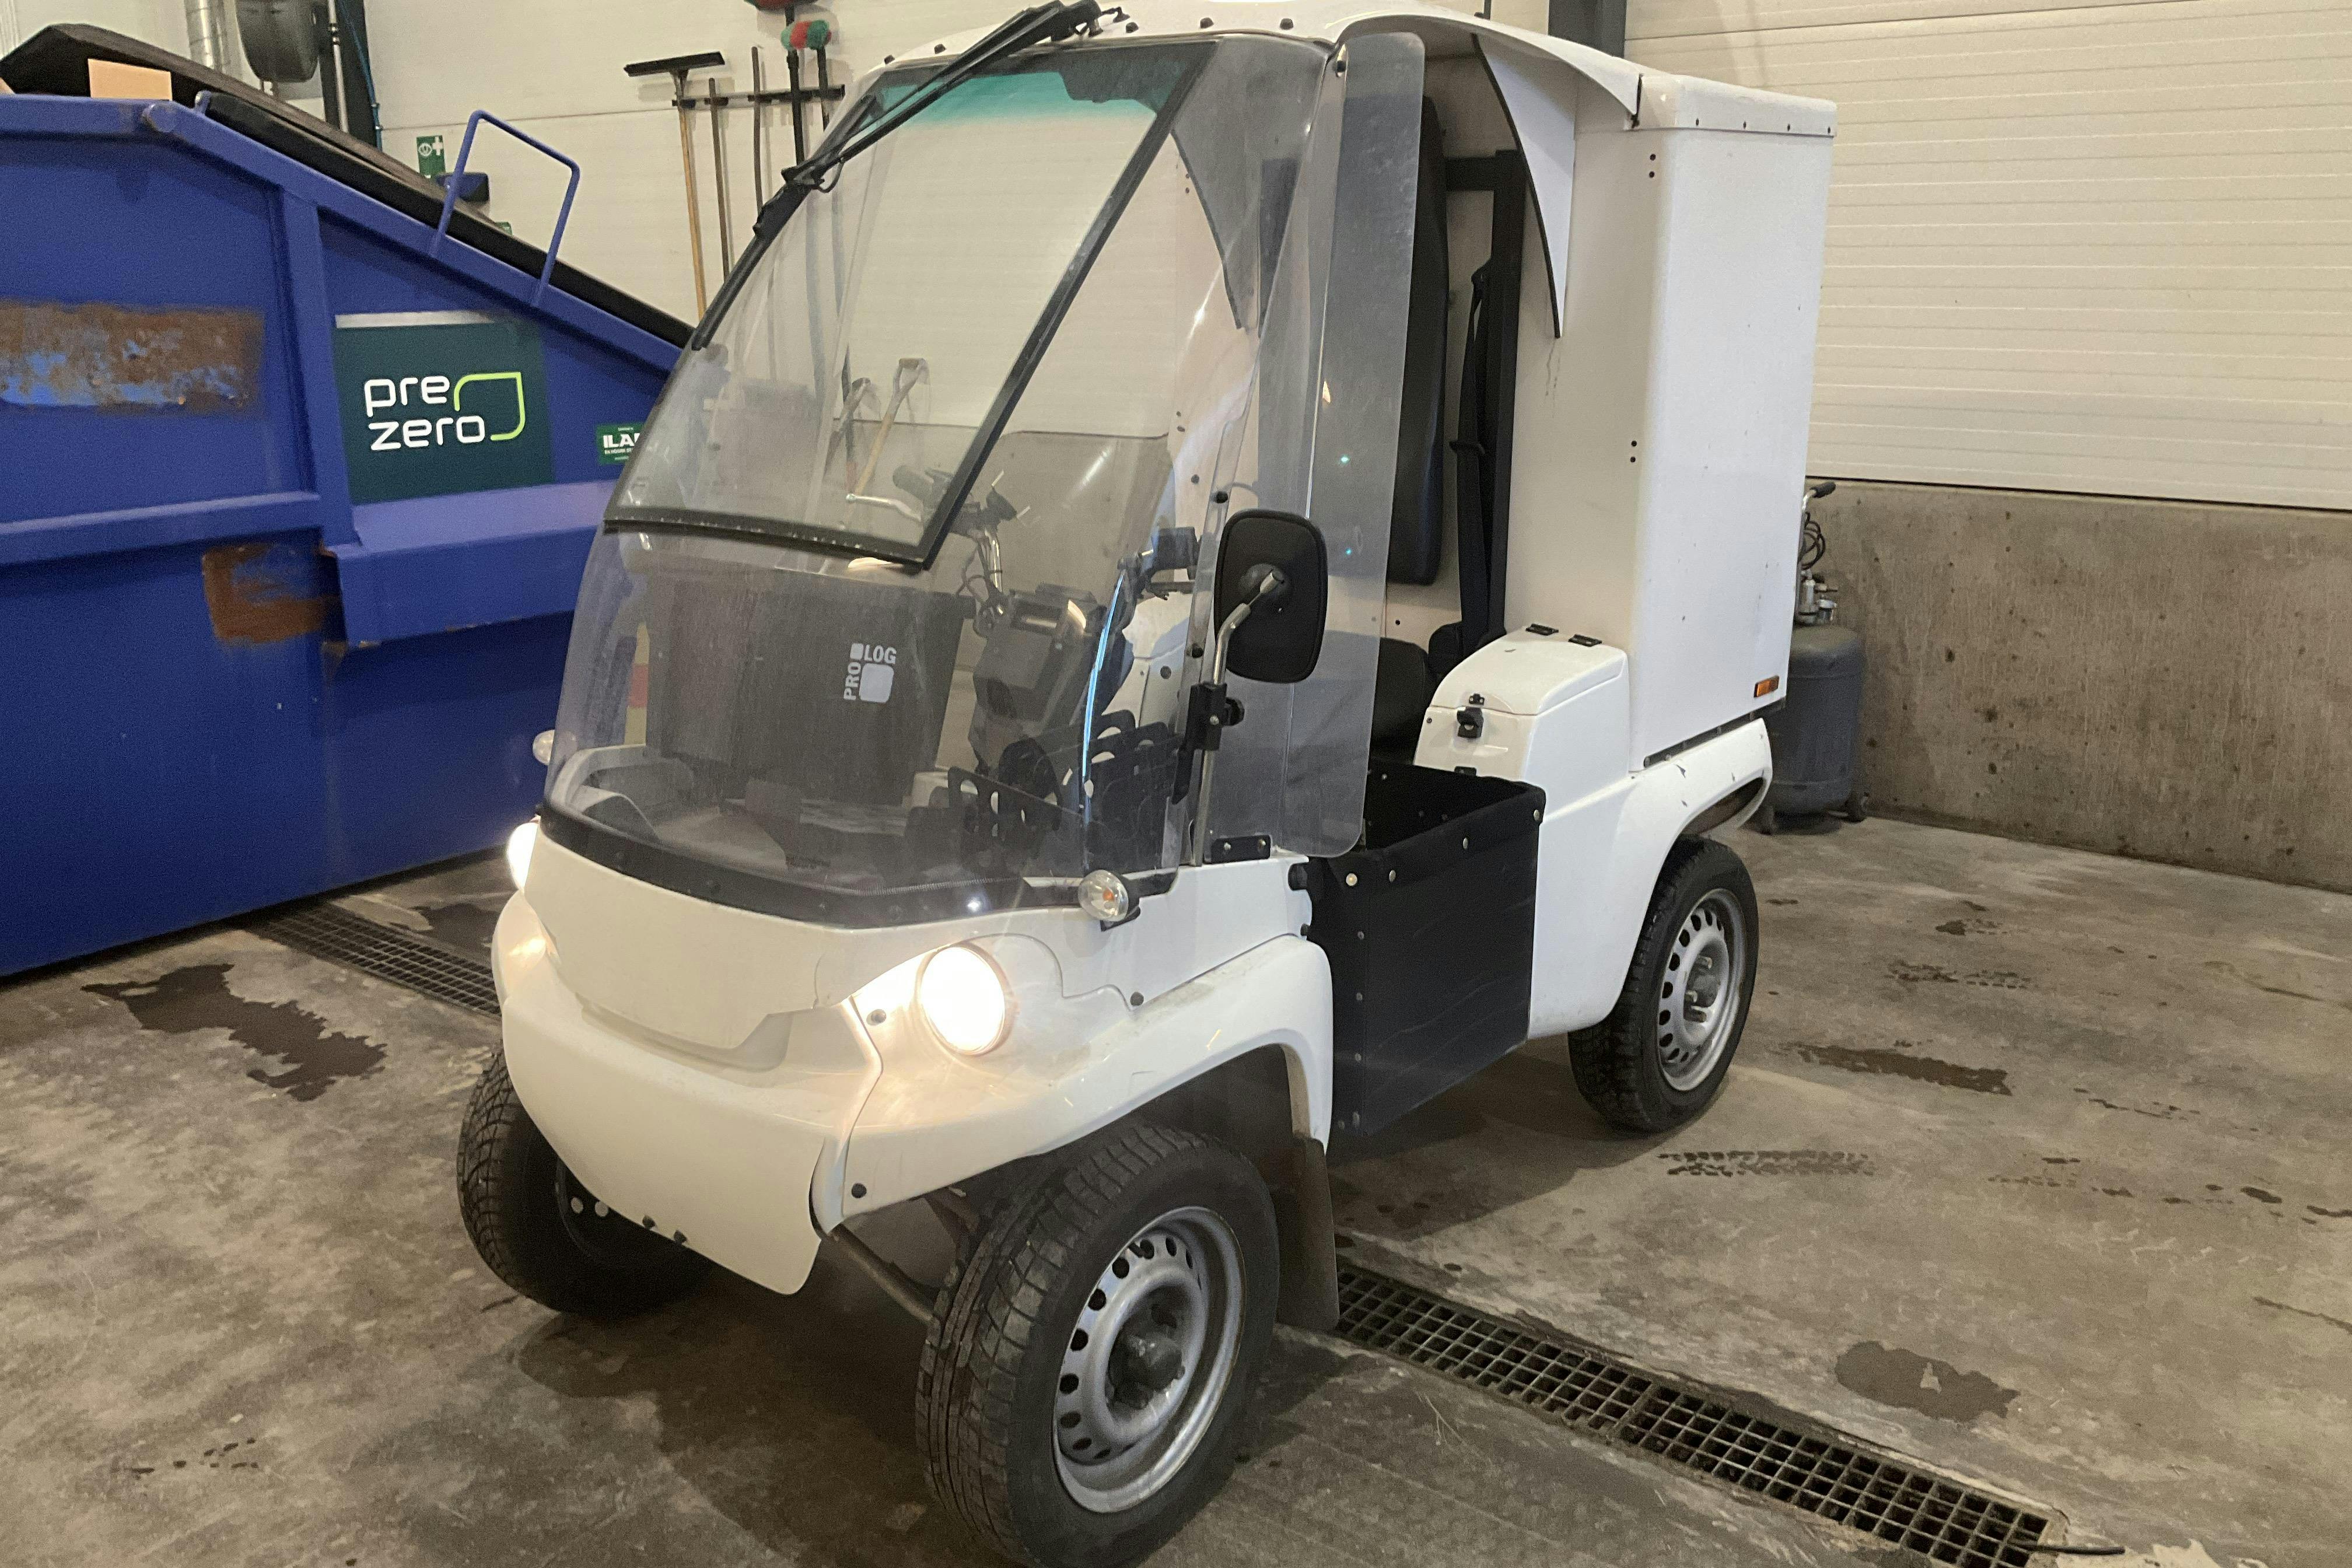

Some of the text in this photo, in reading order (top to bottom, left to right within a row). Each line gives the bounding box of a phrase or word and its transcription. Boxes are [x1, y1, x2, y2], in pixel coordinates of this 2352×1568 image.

[364, 376, 450, 418] pre
[368, 415, 485, 451] zero
[864, 644, 897, 665] LOG
[844, 662, 862, 701] PRO
